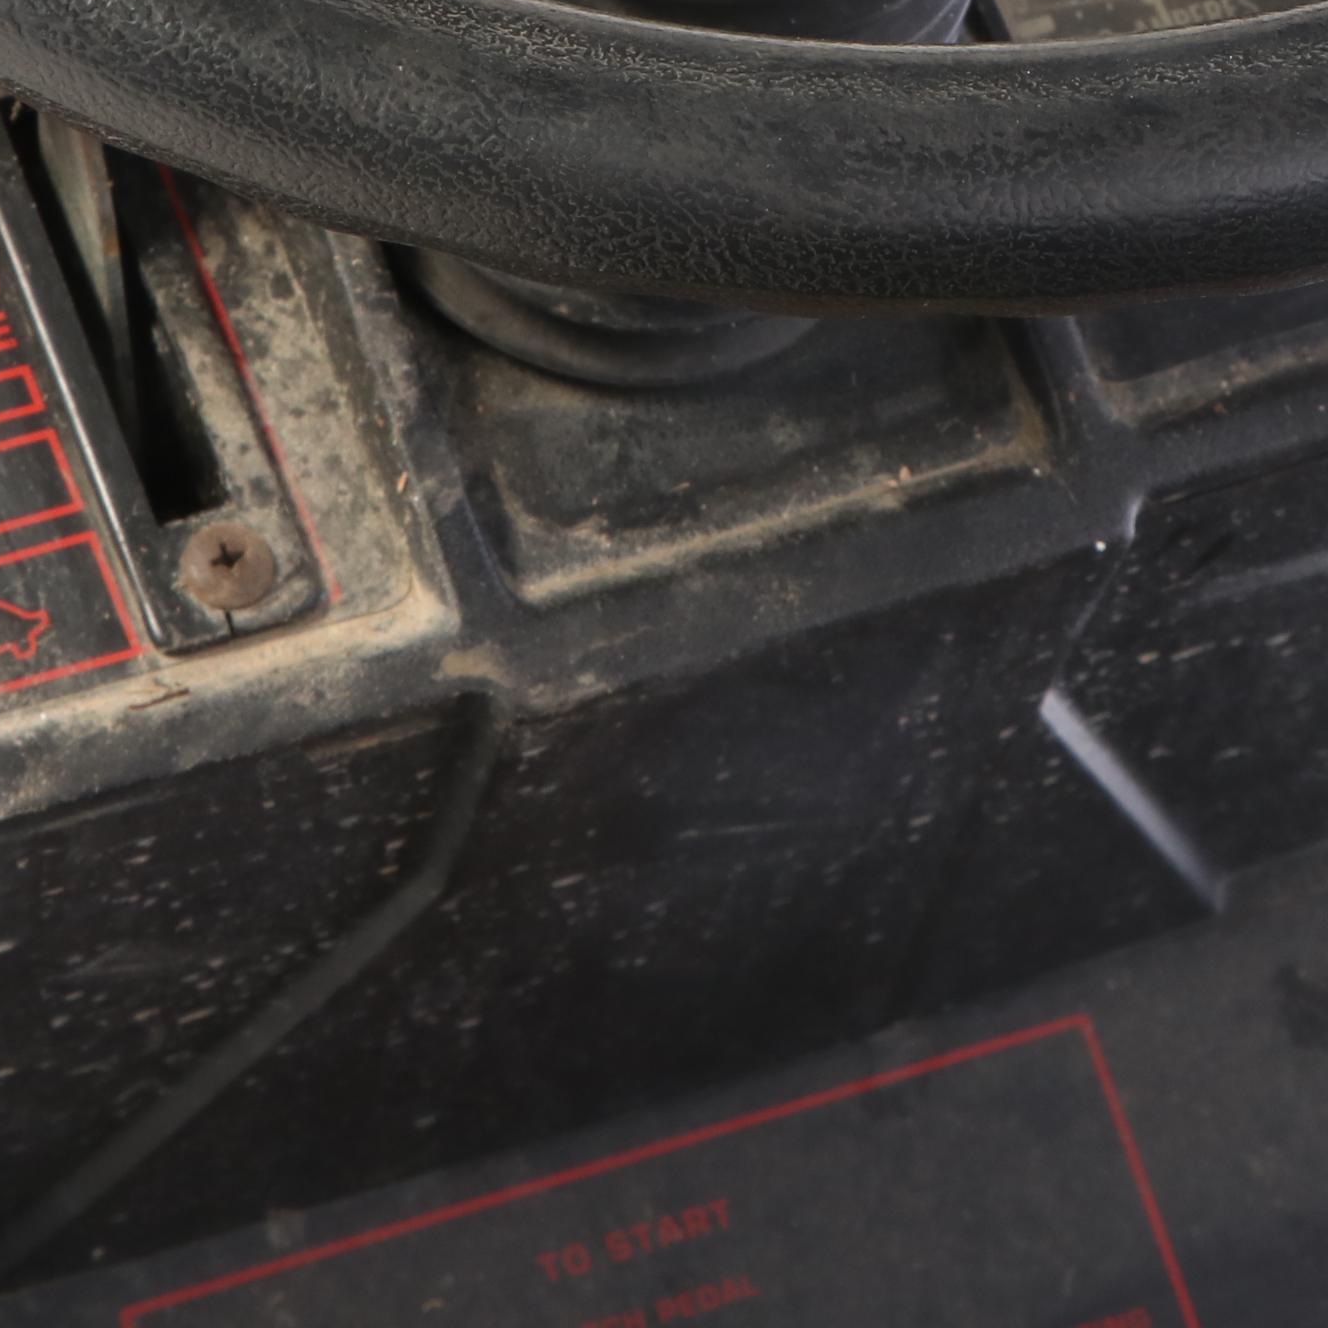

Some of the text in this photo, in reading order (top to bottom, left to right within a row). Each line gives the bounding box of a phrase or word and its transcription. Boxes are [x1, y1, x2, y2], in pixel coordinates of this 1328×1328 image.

[535, 1197, 730, 1283] TO START
[656, 1274, 761, 1323] PEDAL
